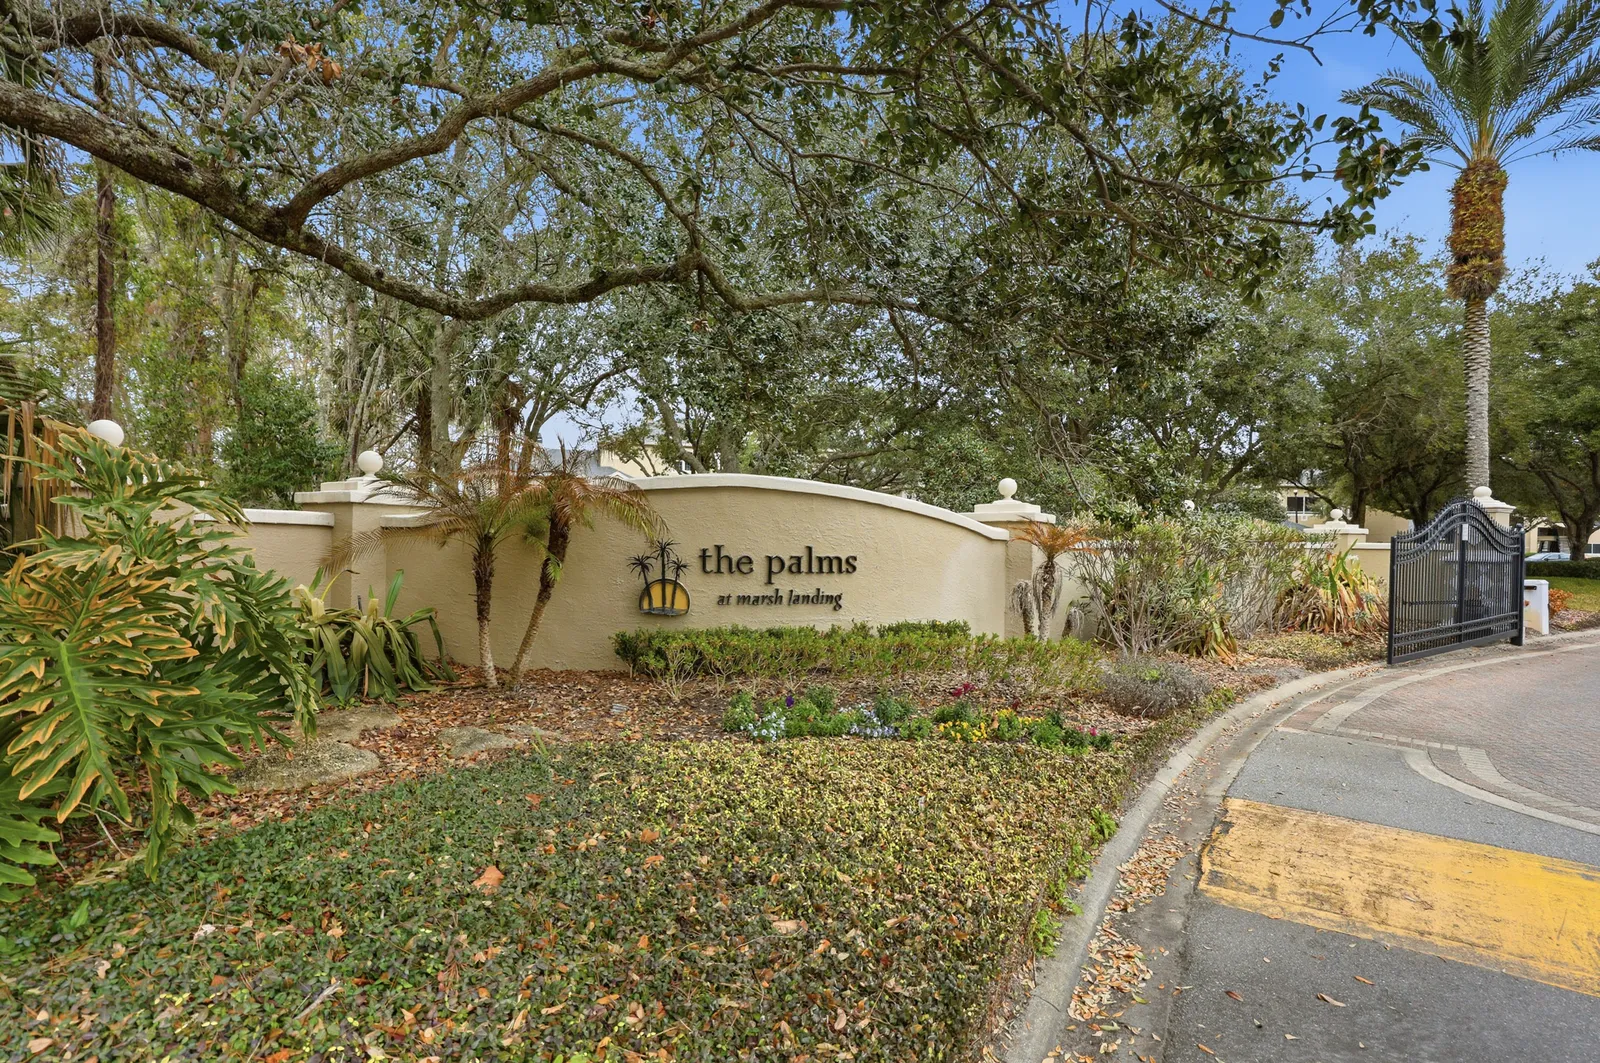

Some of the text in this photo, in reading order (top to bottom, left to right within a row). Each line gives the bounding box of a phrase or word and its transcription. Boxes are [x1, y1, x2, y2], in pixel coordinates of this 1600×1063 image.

[699, 544, 858, 585] the palms
[717, 587, 843, 611] at marsh landing
